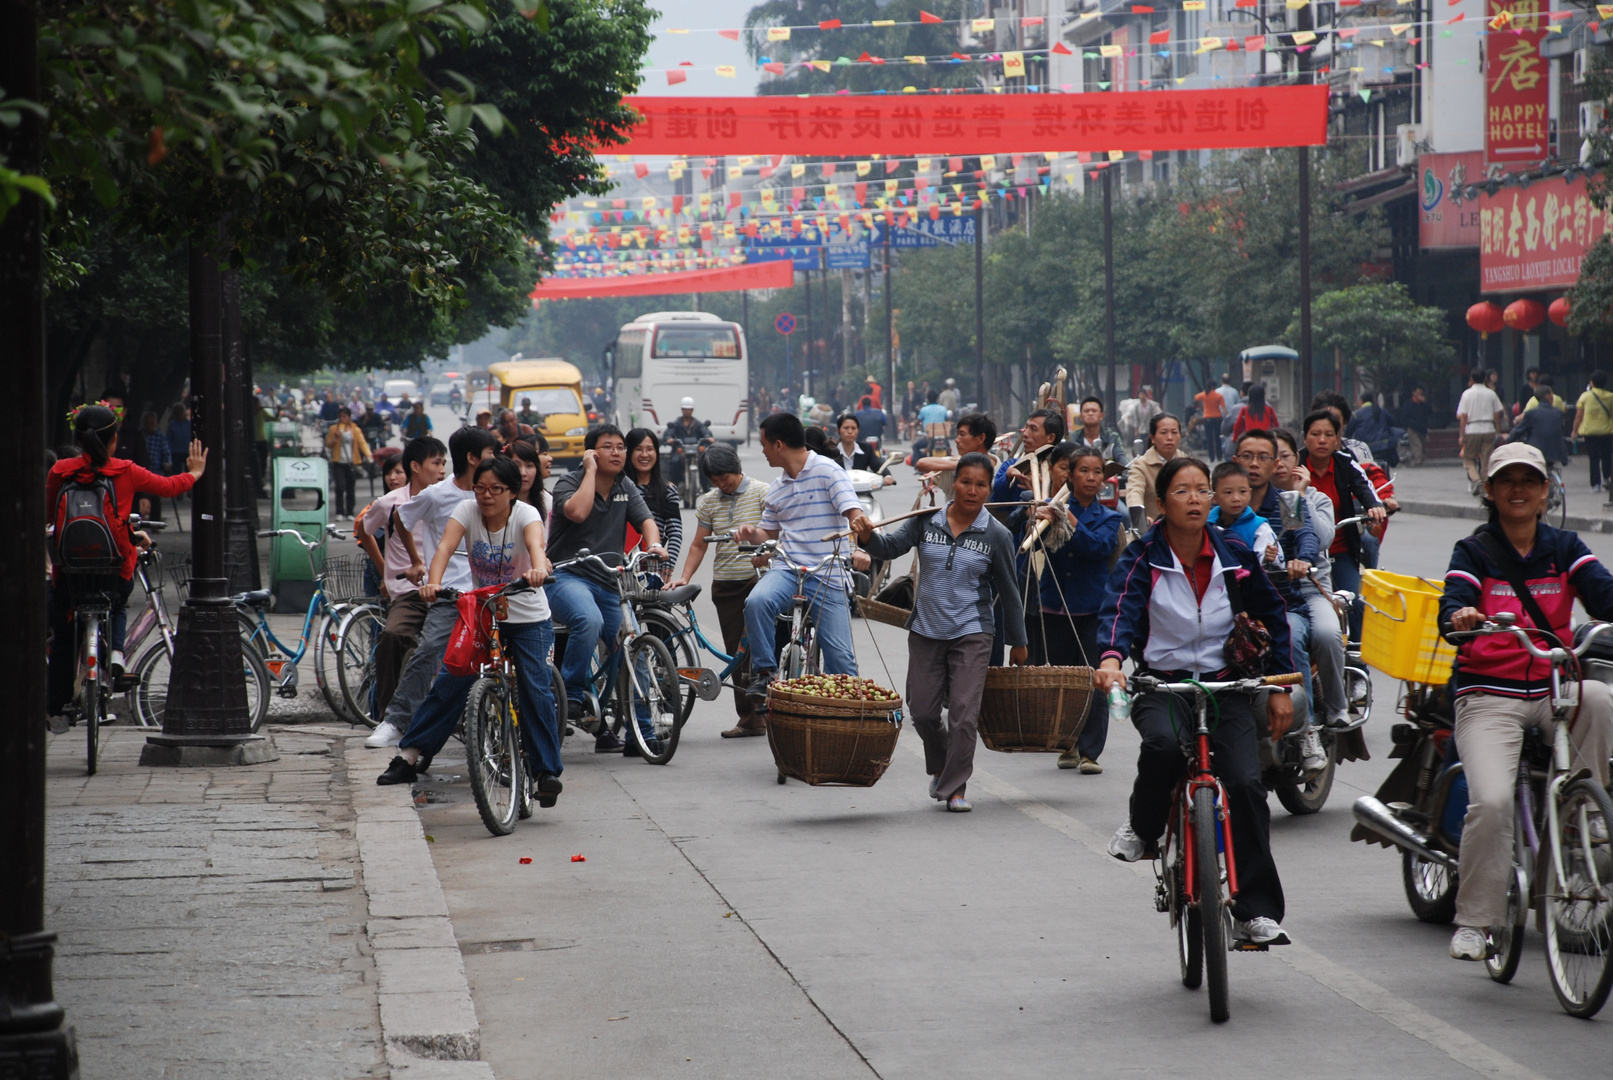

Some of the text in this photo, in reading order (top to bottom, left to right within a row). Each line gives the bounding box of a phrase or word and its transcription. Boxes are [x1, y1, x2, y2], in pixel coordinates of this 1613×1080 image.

[1489, 103, 1546, 122] HAPPY
[1490, 122, 1546, 140] HOTEL
[1484, 264, 1520, 284] YANGSHUO
[1553, 256, 1576, 278] LOCAL
